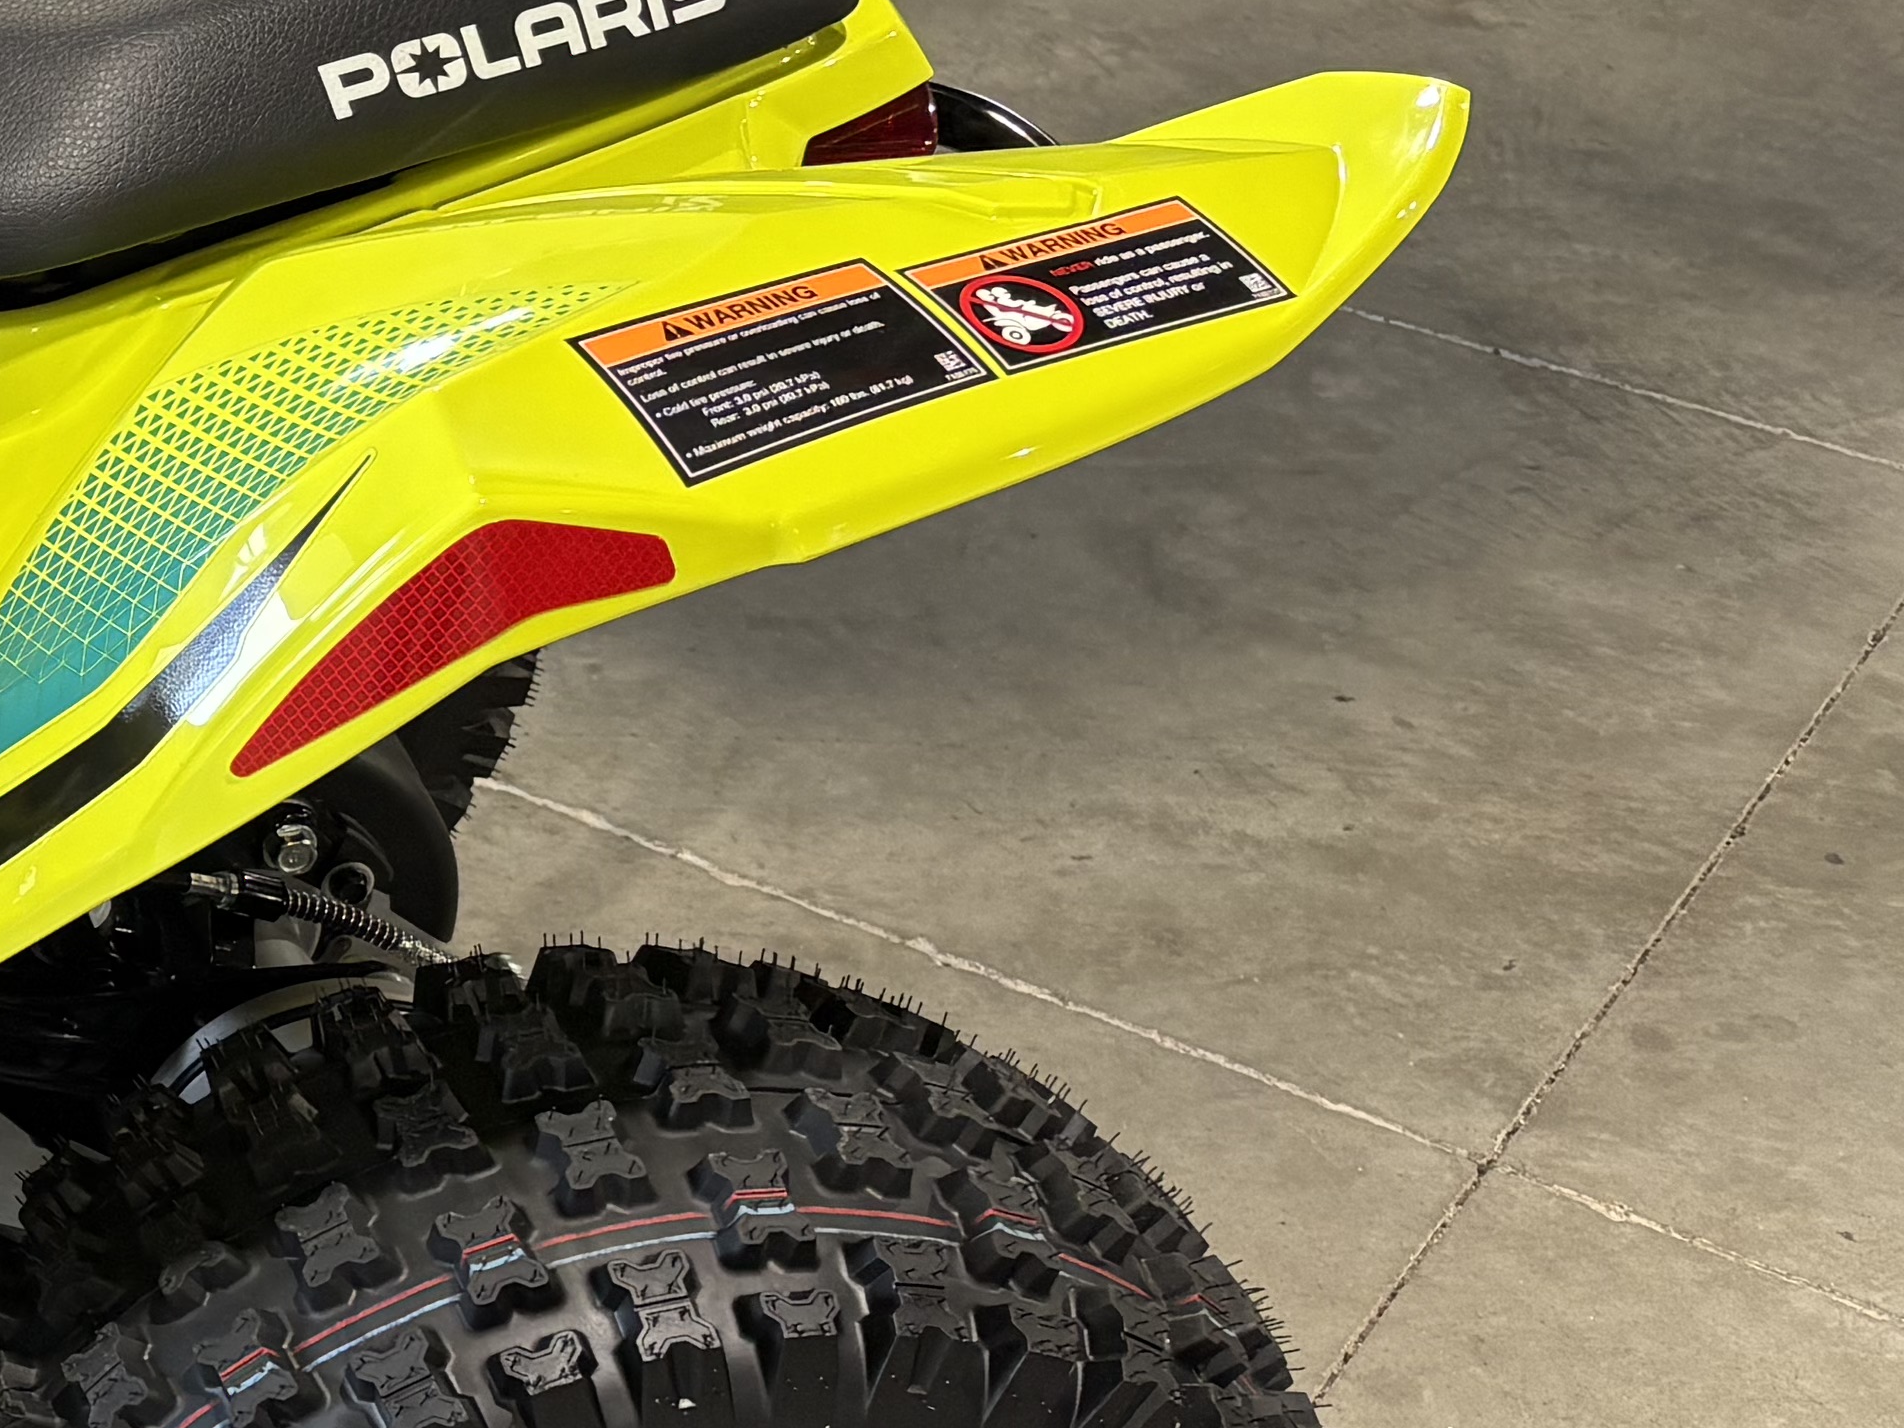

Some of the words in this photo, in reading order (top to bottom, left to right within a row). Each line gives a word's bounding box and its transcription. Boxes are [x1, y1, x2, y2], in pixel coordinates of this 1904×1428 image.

[1000, 222, 1127, 262] WARNING
[683, 285, 819, 330] WARNING
[1092, 297, 1146, 317] SEVERE
[1103, 309, 1154, 329] DEATH.
[663, 400, 690, 416] Cold
